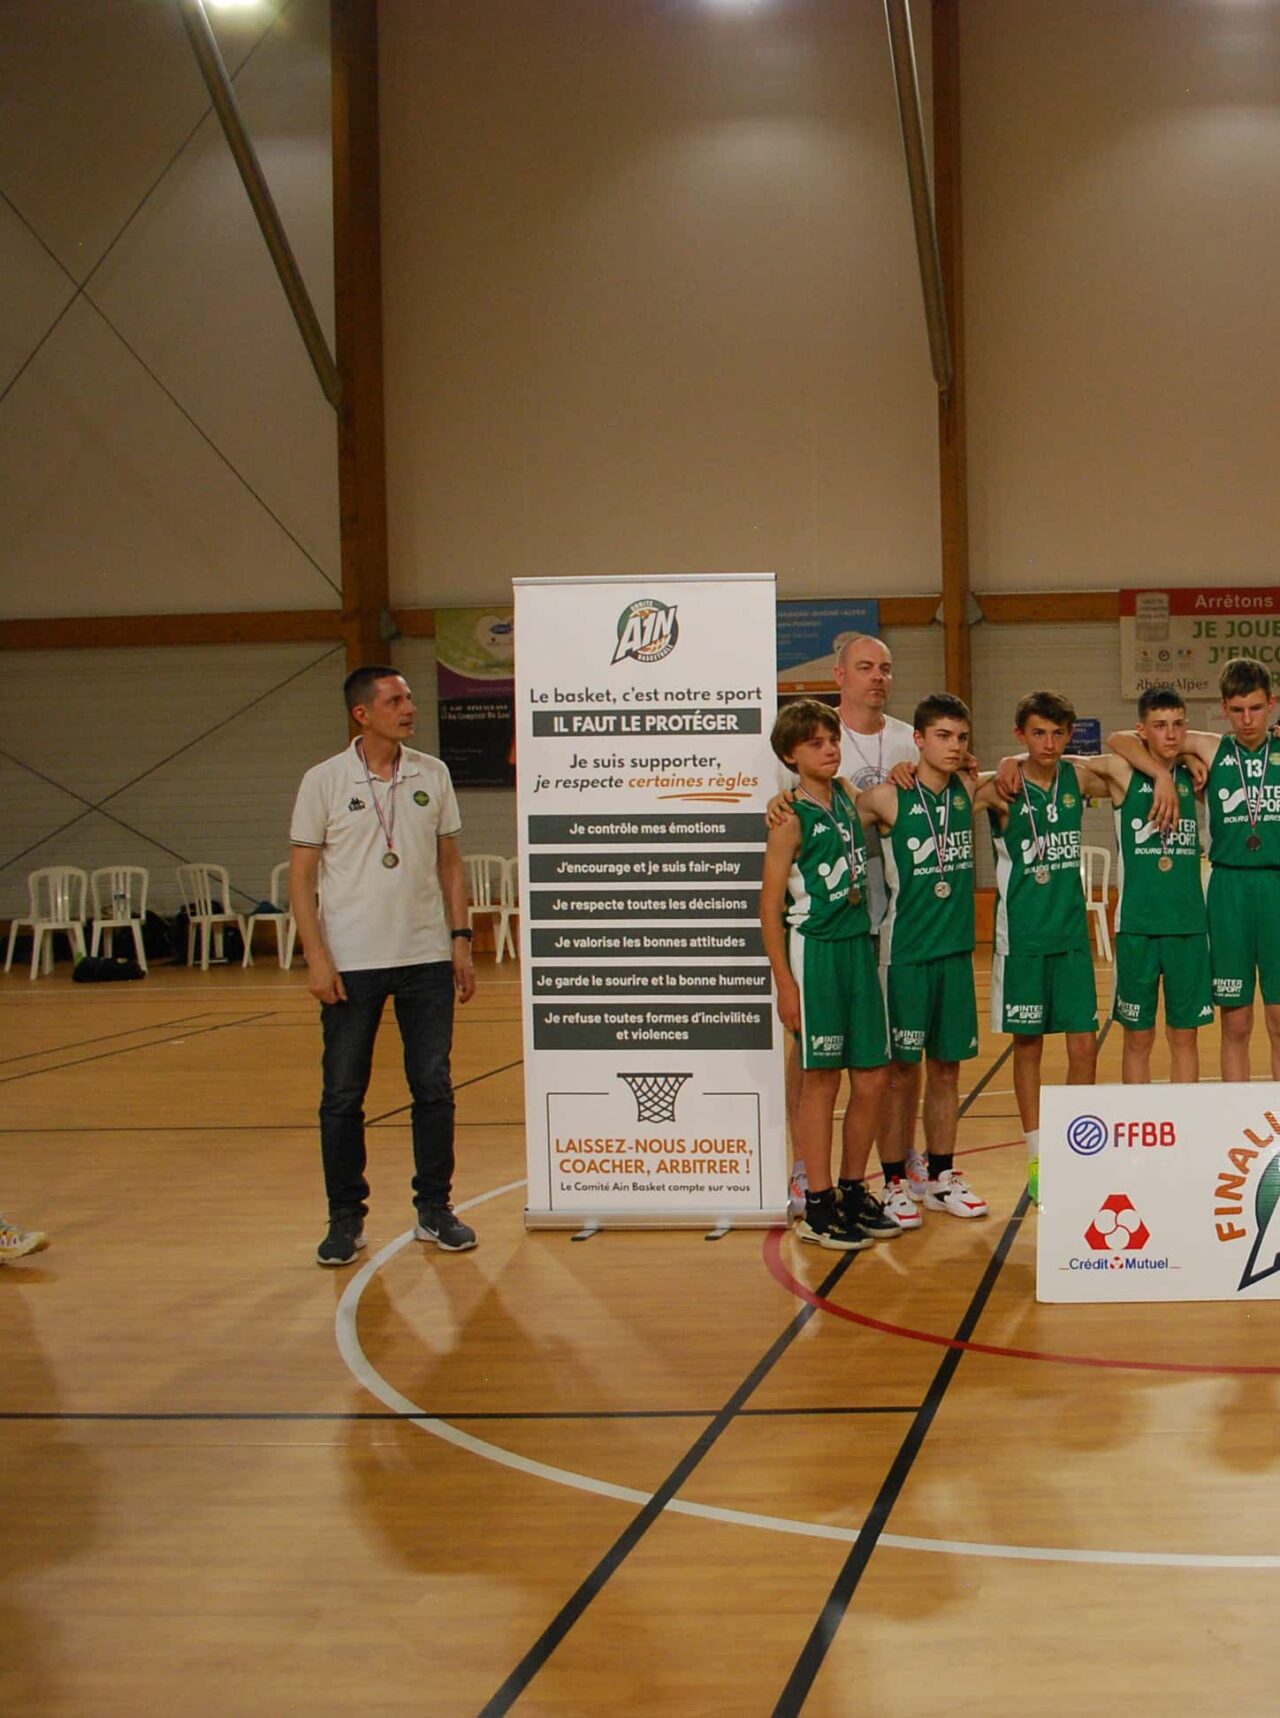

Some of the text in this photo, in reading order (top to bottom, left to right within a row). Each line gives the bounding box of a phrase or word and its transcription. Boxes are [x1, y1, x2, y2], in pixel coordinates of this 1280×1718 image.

[1194, 594, 1273, 608] Arrêtons
[1192, 620, 1217, 639] JE
[529, 687, 762, 704] Le basket, c'est notre sport
[553, 710, 739, 732] IL FAUT LE PROTÉGER
[570, 753, 721, 771] Je suis supporter,
[1245, 758, 1263, 778] 13
[534, 772, 759, 792] je respecte certaines règles
[1046, 803, 1059, 823] 8
[569, 822, 726, 835] Je contrôle mes émotions
[837, 822, 851, 842] 5
[1178, 819, 1197, 832] TER
[1045, 830, 1081, 847] INTE
[1168, 832, 1196, 846] PORT
[1047, 845, 1081, 861] SPOR
[556, 860, 741, 876] J'encourage et je suis fair-play
[552, 897, 748, 913] Je respecte toutes les décisions
[554, 935, 746, 948] Je valorise les bonnes attitudes
[537, 974, 767, 989] Je garde le sourire et la bonne humeur
[544, 1011, 760, 1024] Je refuse toutes formes d'incivilités
[616, 1028, 689, 1040] et violences
[1113, 1121, 1176, 1148] FFBB
[555, 1138, 753, 1156] LAISSEZ-NOUS JOUER,
[559, 1158, 751, 1177] COACHER, ARBITRER !
[560, 1180, 751, 1194] Le Comité Ain Basket compte sur vous
[1069, 1257, 1169, 1270] Crédit Mutuel
